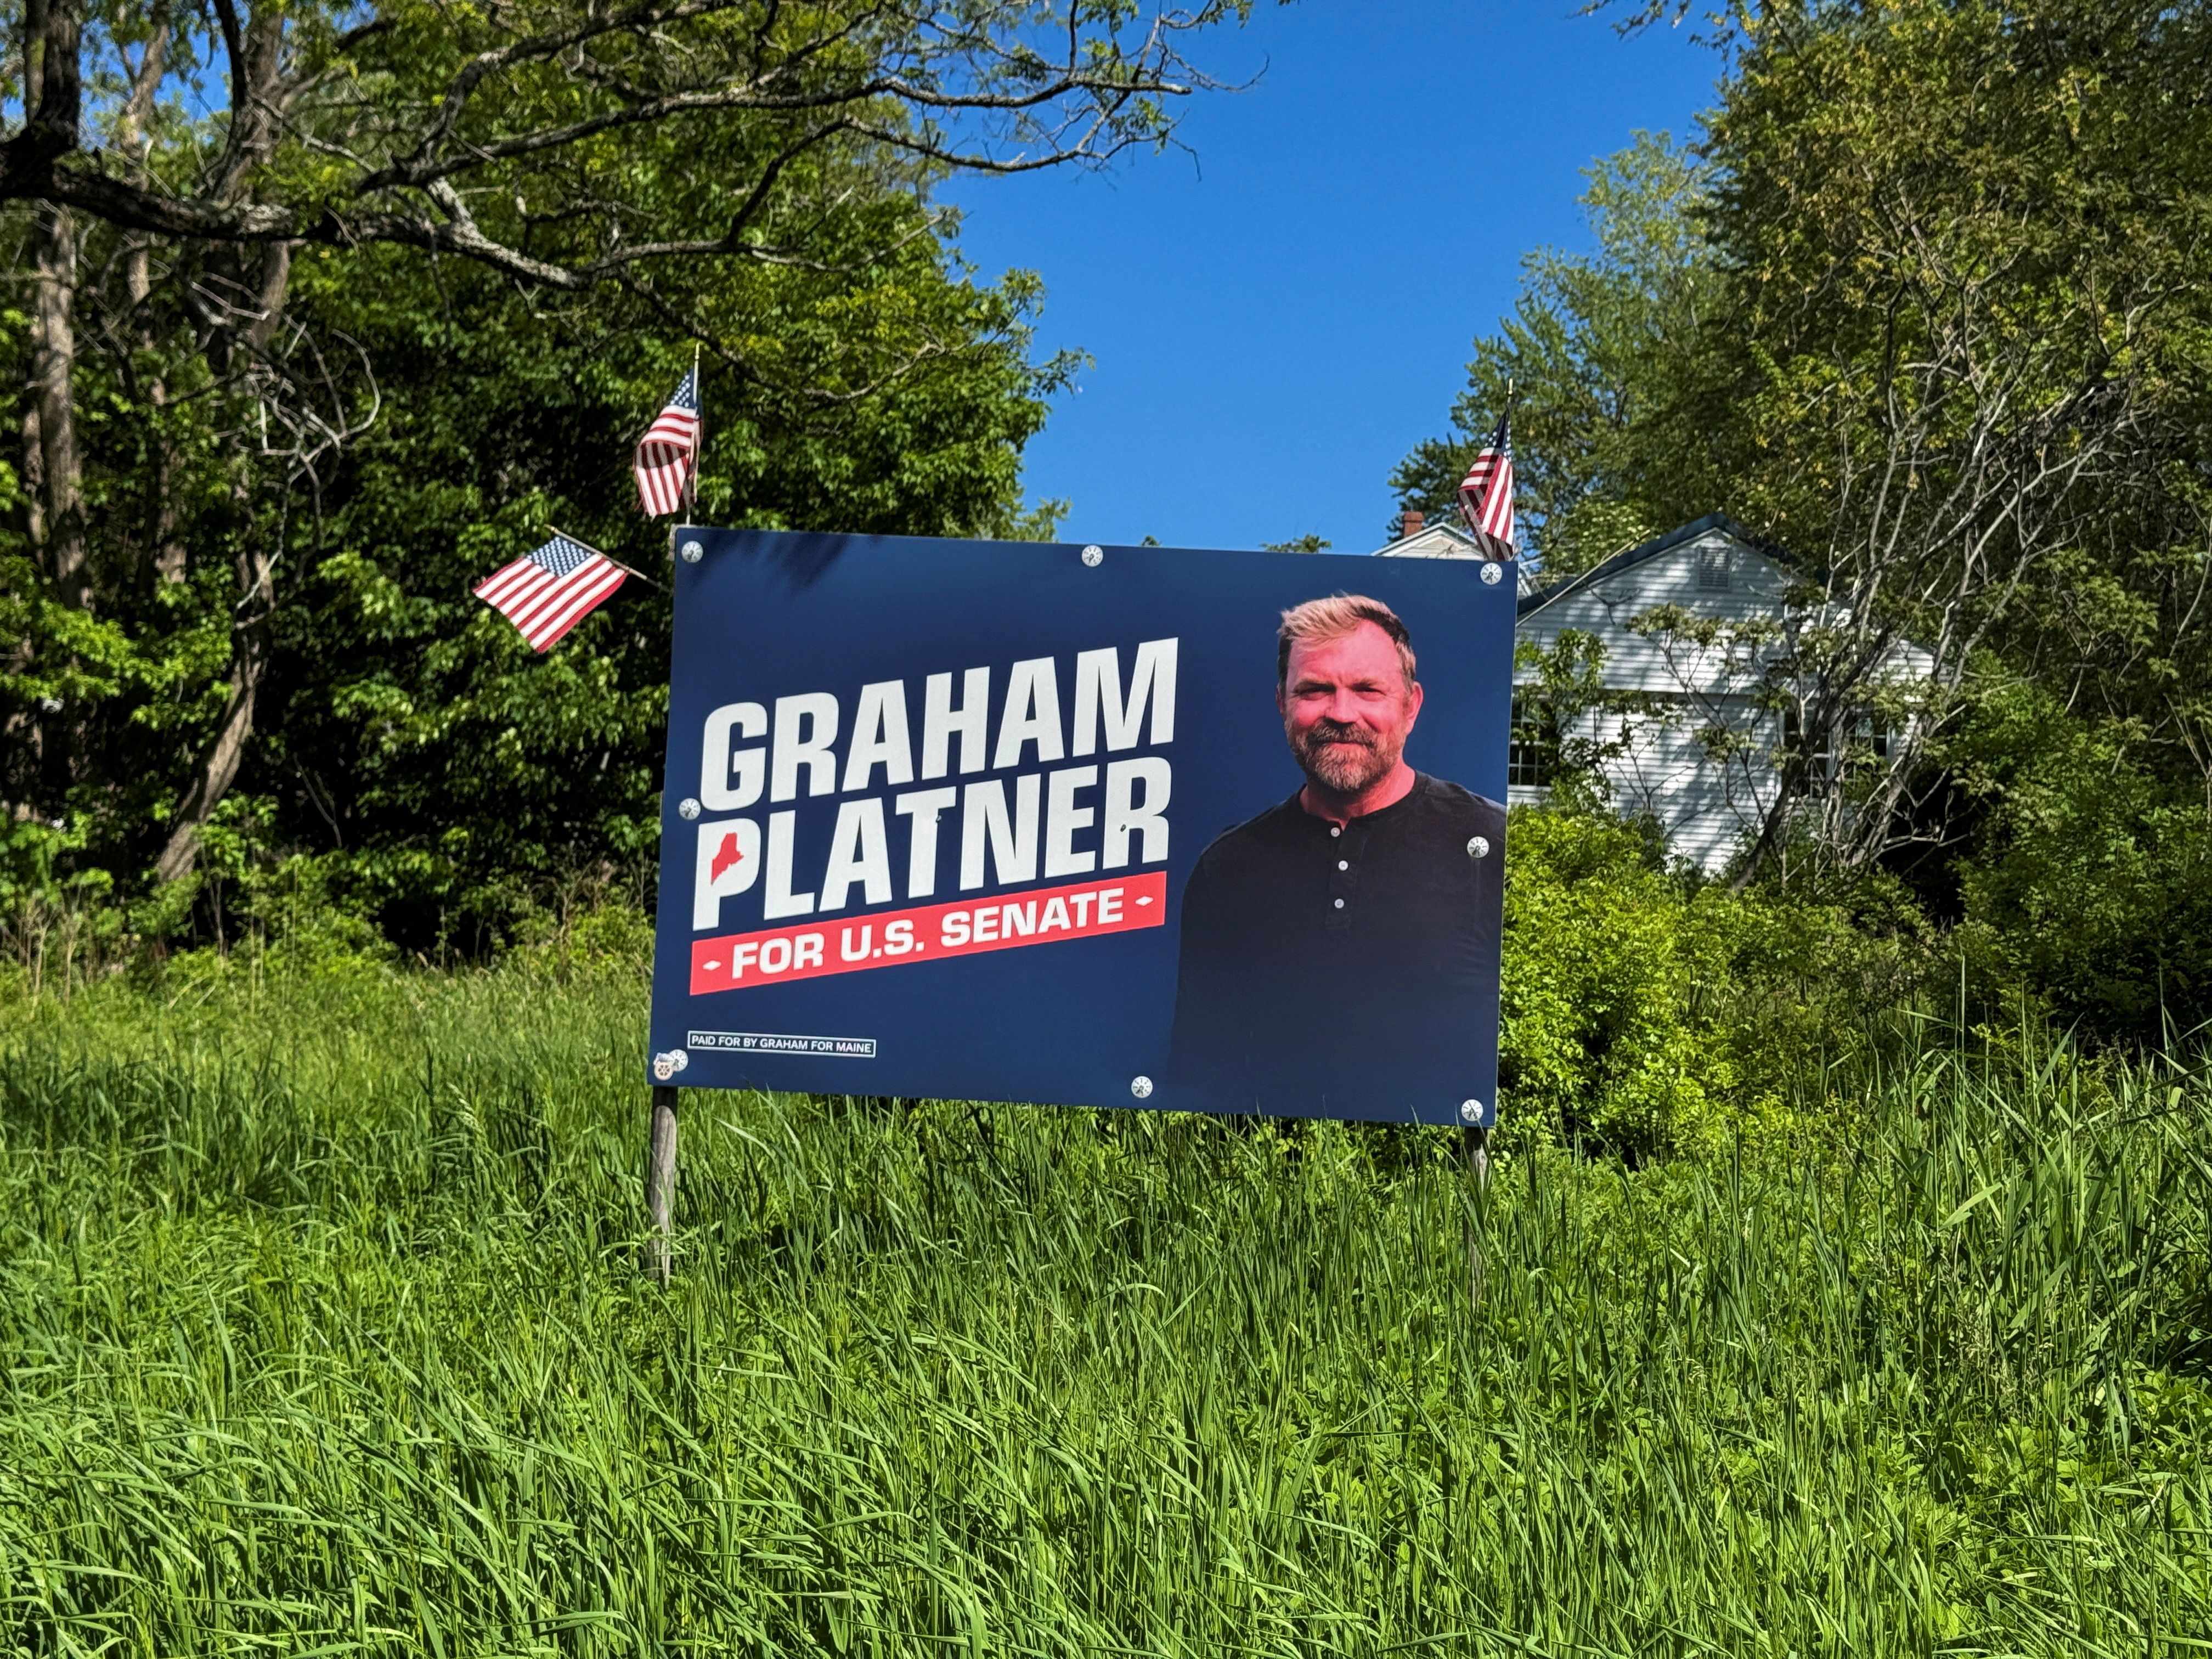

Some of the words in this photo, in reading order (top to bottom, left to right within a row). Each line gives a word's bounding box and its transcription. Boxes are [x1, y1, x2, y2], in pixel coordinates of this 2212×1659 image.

[700, 637, 1178, 812] GRAHAM
[693, 757, 1172, 931] PLATNER
[732, 933, 824, 979] FOR
[840, 919, 925, 962] U.S.
[941, 888, 1124, 947] SENATE
[691, 1035, 715, 1046] PAID
[718, 1036, 741, 1047] FOR
[743, 1037, 758, 1048] BY
[760, 1038, 808, 1050] GRAHAM
[811, 1040, 833, 1051] FOR
[836, 1042, 872, 1053] MAINE
